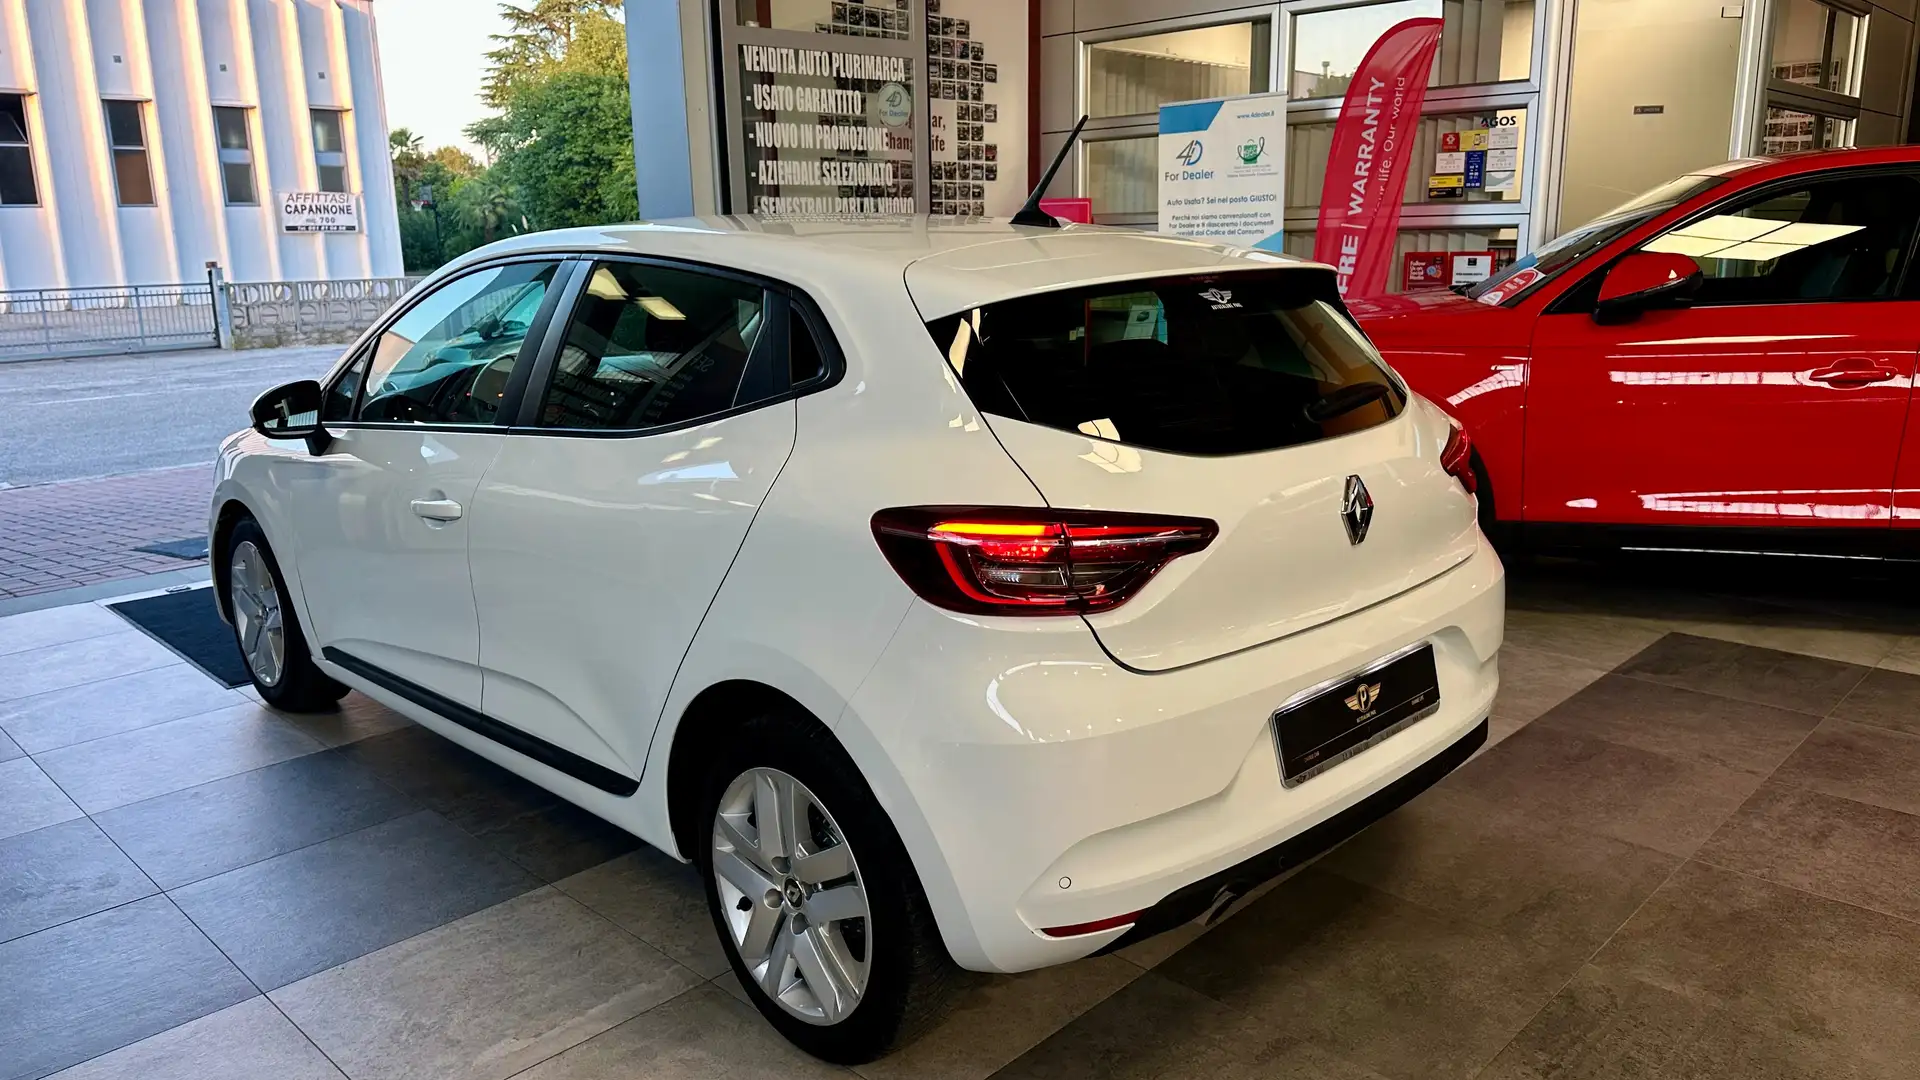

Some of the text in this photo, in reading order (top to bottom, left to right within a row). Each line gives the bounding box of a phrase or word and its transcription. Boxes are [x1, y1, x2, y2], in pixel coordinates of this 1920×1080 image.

[743, 45, 905, 82] VENDITA AUTO PLURIMARCA
[753, 84, 862, 115] USATO GARANTITO
[1392, 77, 1405, 119] world
[931, 115, 946, 131] ar,
[1480, 116, 1516, 127] AGOS
[756, 122, 889, 151] NUOVO IN PROMOZIONE
[1347, 77, 1385, 216] WARRANTY
[1383, 123, 1396, 152] Our
[759, 160, 893, 186] AZIENDALE SELEZIONATO
[1164, 170, 1214, 181] For Dealer
[1378, 157, 1392, 181] life.
[285, 204, 353, 214] CAPANNONE
[286, 194, 350, 203] AFFITTASI
[1184, 198, 1205, 206] Usata?
[1229, 196, 1248, 204] posto
[1249, 194, 1277, 202] GIUSTO!
